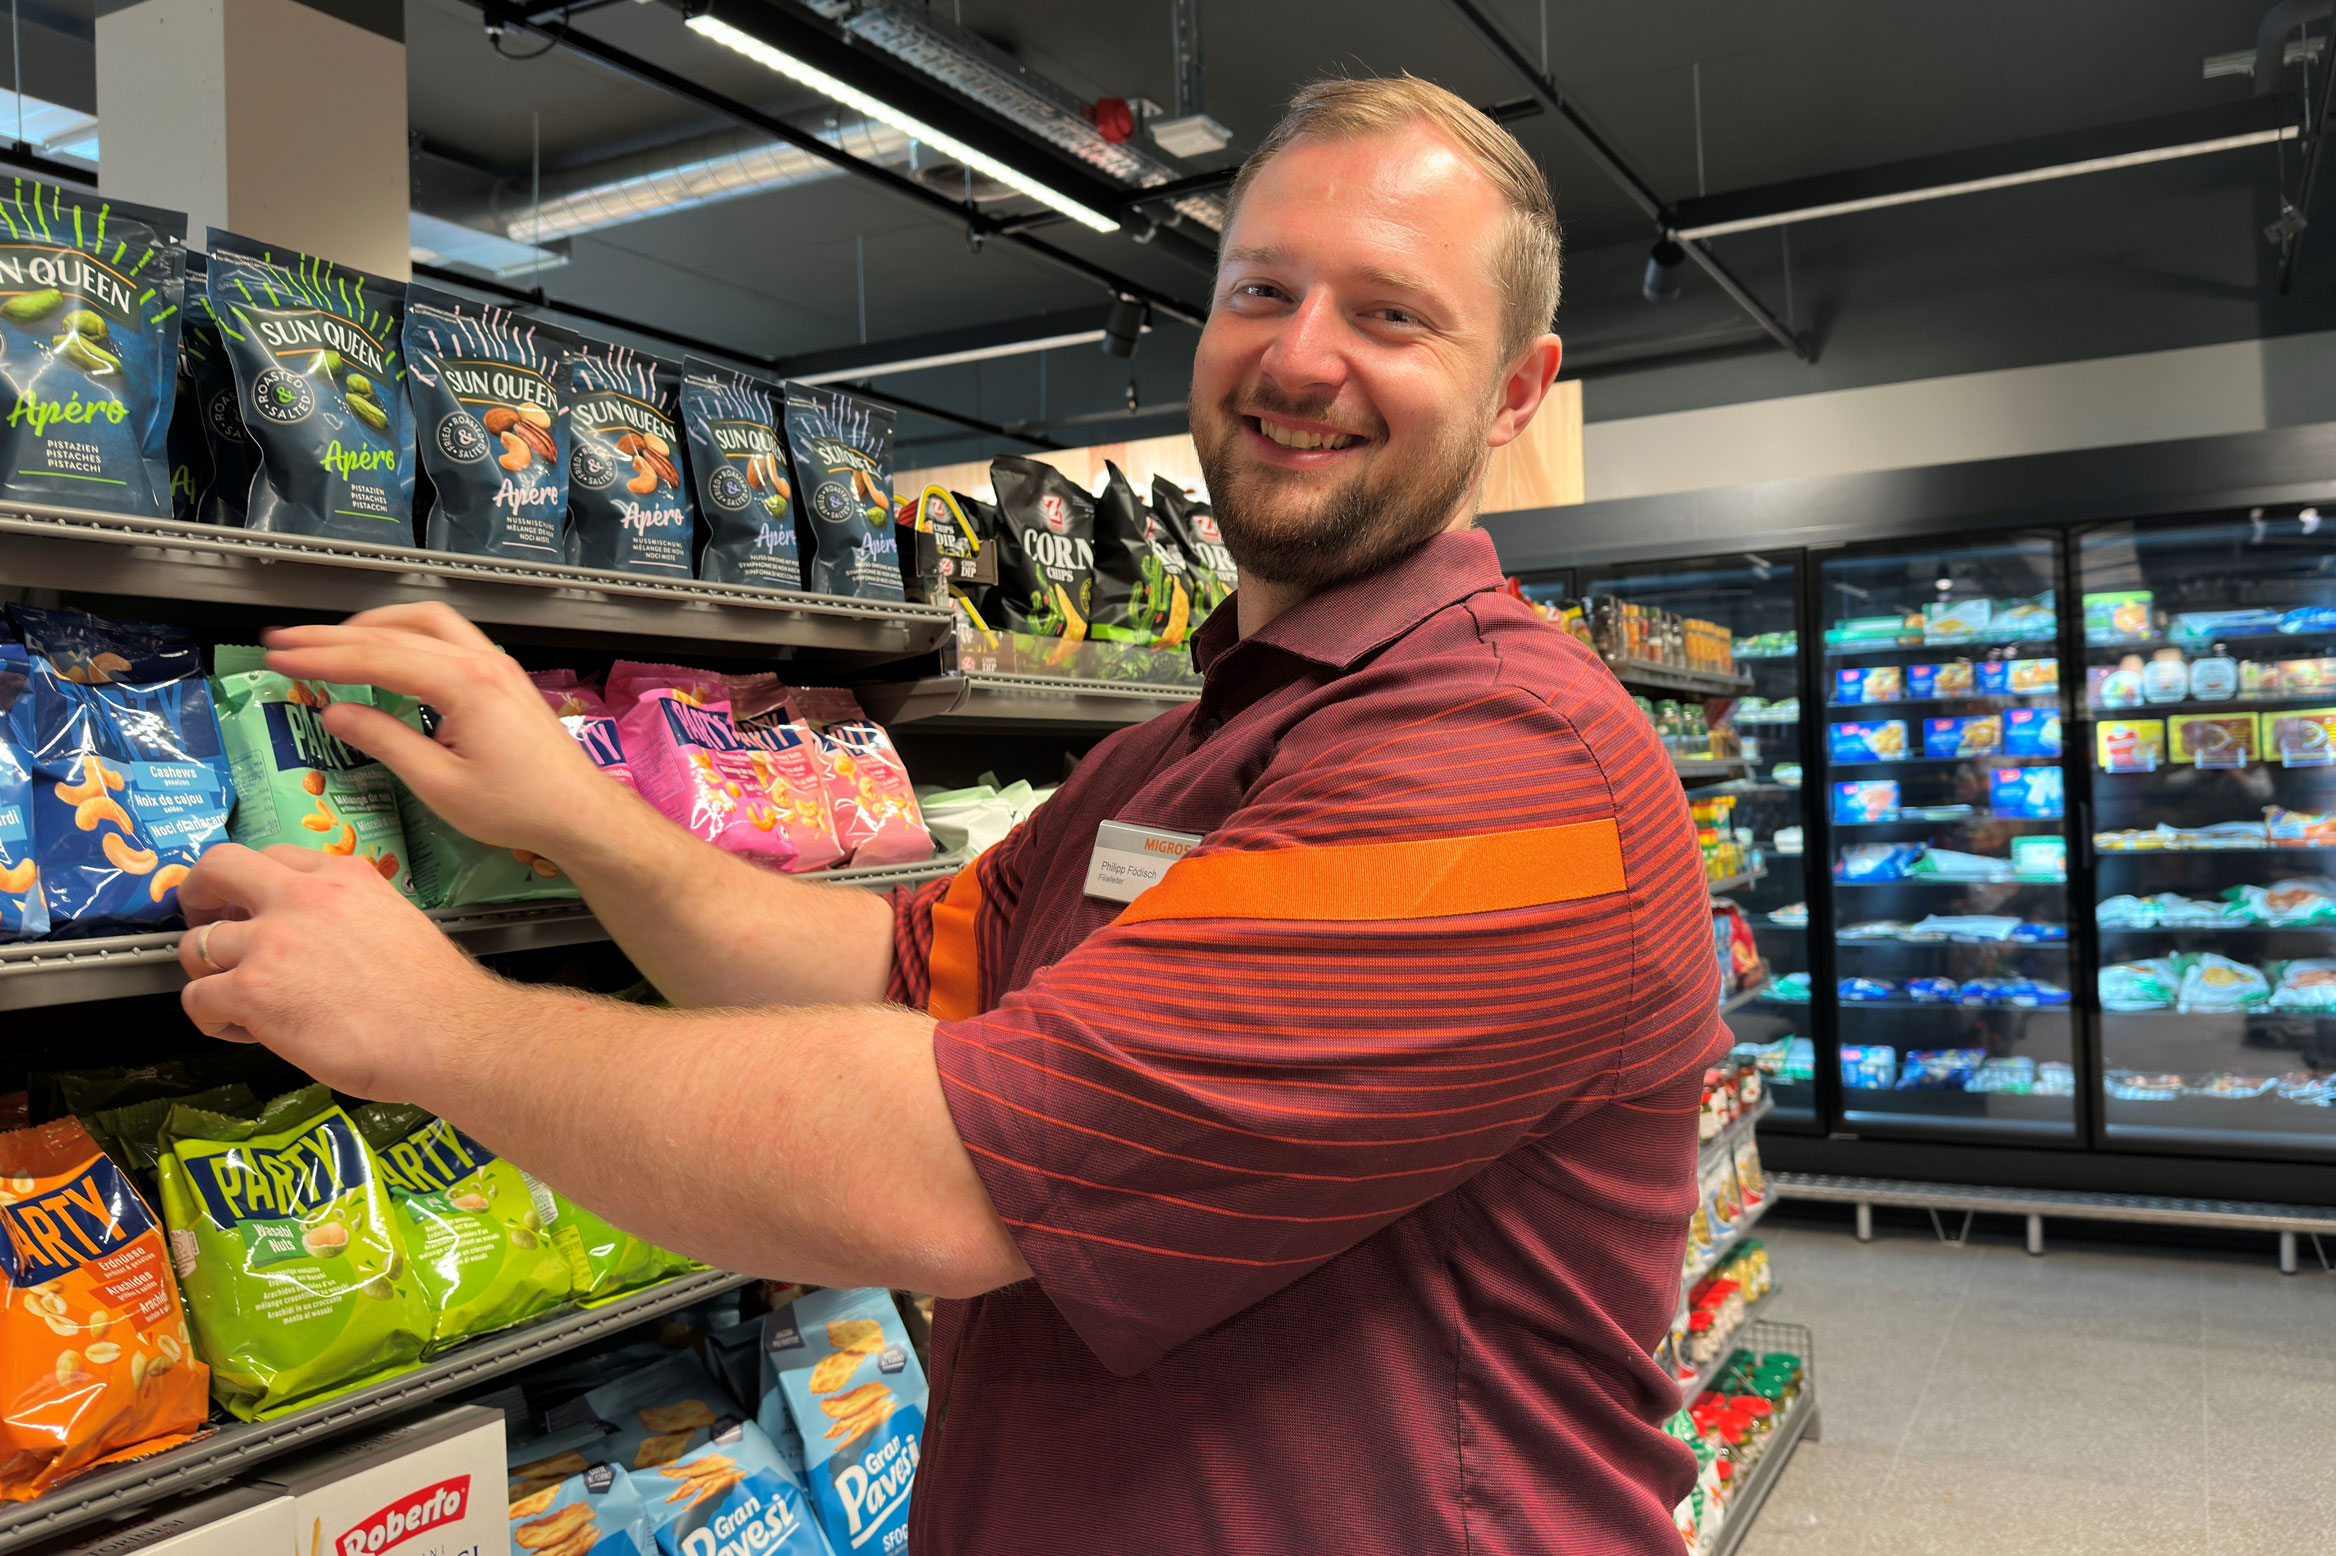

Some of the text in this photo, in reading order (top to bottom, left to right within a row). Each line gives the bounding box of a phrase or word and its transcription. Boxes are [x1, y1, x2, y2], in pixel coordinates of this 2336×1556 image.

[0, 256, 131, 314] N QUEEN
[260, 320, 385, 374] SUN QUEEN
[258, 371, 304, 404] ROASTED
[275, 386, 298, 404] &
[446, 370, 559, 413] SUN QUEEN
[7, 391, 129, 437] Apéro
[267, 395, 312, 421] SALTED
[451, 415, 485, 440] ROASTED
[576, 401, 677, 443] SUN QUEEN
[441, 426, 456, 452] FRIED
[458, 428, 477, 445] &
[715, 429, 749, 450] SUN
[47, 440, 100, 454] PISTAZIEN
[458, 441, 487, 459] SALTED
[46, 449, 102, 464] PISTACHES
[319, 439, 396, 482] Apéro
[587, 458, 605, 473] &
[47, 459, 102, 473] PISTACCHI
[351, 484, 386, 496] PISTAZIEN
[726, 480, 741, 495] &
[351, 492, 388, 505] PISTACHES
[352, 500, 389, 513] PISTACCHI
[829, 495, 844, 508] &
[620, 501, 685, 537] Apéro
[1042, 495, 1063, 526] Z
[933, 522, 955, 535] CHIPS
[935, 532, 957, 548] DIP
[645, 552, 661, 560] NOCI
[1023, 528, 1095, 571] CORN
[1189, 541, 1238, 571] OR
[960, 559, 977, 568] CHIPS
[960, 566, 977, 578] DIP
[1046, 566, 1075, 583] CHIPS
[670, 700, 738, 750] PARTY
[149, 765, 198, 779] Cashews
[134, 792, 205, 808] Noix de cajou
[333, 794, 368, 806] Mélange
[150, 822, 177, 839] Noci
[1144, 838, 1192, 856] MIGROS
[1101, 860, 1126, 875] Philipp
[377, 1118, 476, 1192] ARTY
[209, 1130, 344, 1218] PARTY
[1, 1175, 127, 1277] ARTY
[253, 1223, 295, 1239] Wasabi
[268, 1239, 297, 1254] Nuts
[97, 1246, 147, 1271] Erdnüsse
[105, 1271, 154, 1296] Arachides
[263, 1287, 296, 1300] Arachides
[254, 1299, 283, 1312] mélange
[266, 1306, 295, 1320] Arachidi
[303, 1302, 313, 1311] un
[312, 1295, 343, 1308] croccante
[283, 1315, 304, 1326] manto
[311, 1306, 334, 1318] wasabi
[865, 1435, 901, 1475] Gran
[835, 1433, 920, 1537] Pavesi
[343, 1487, 461, 1556] Roberto
[714, 1496, 761, 1540] Gran
